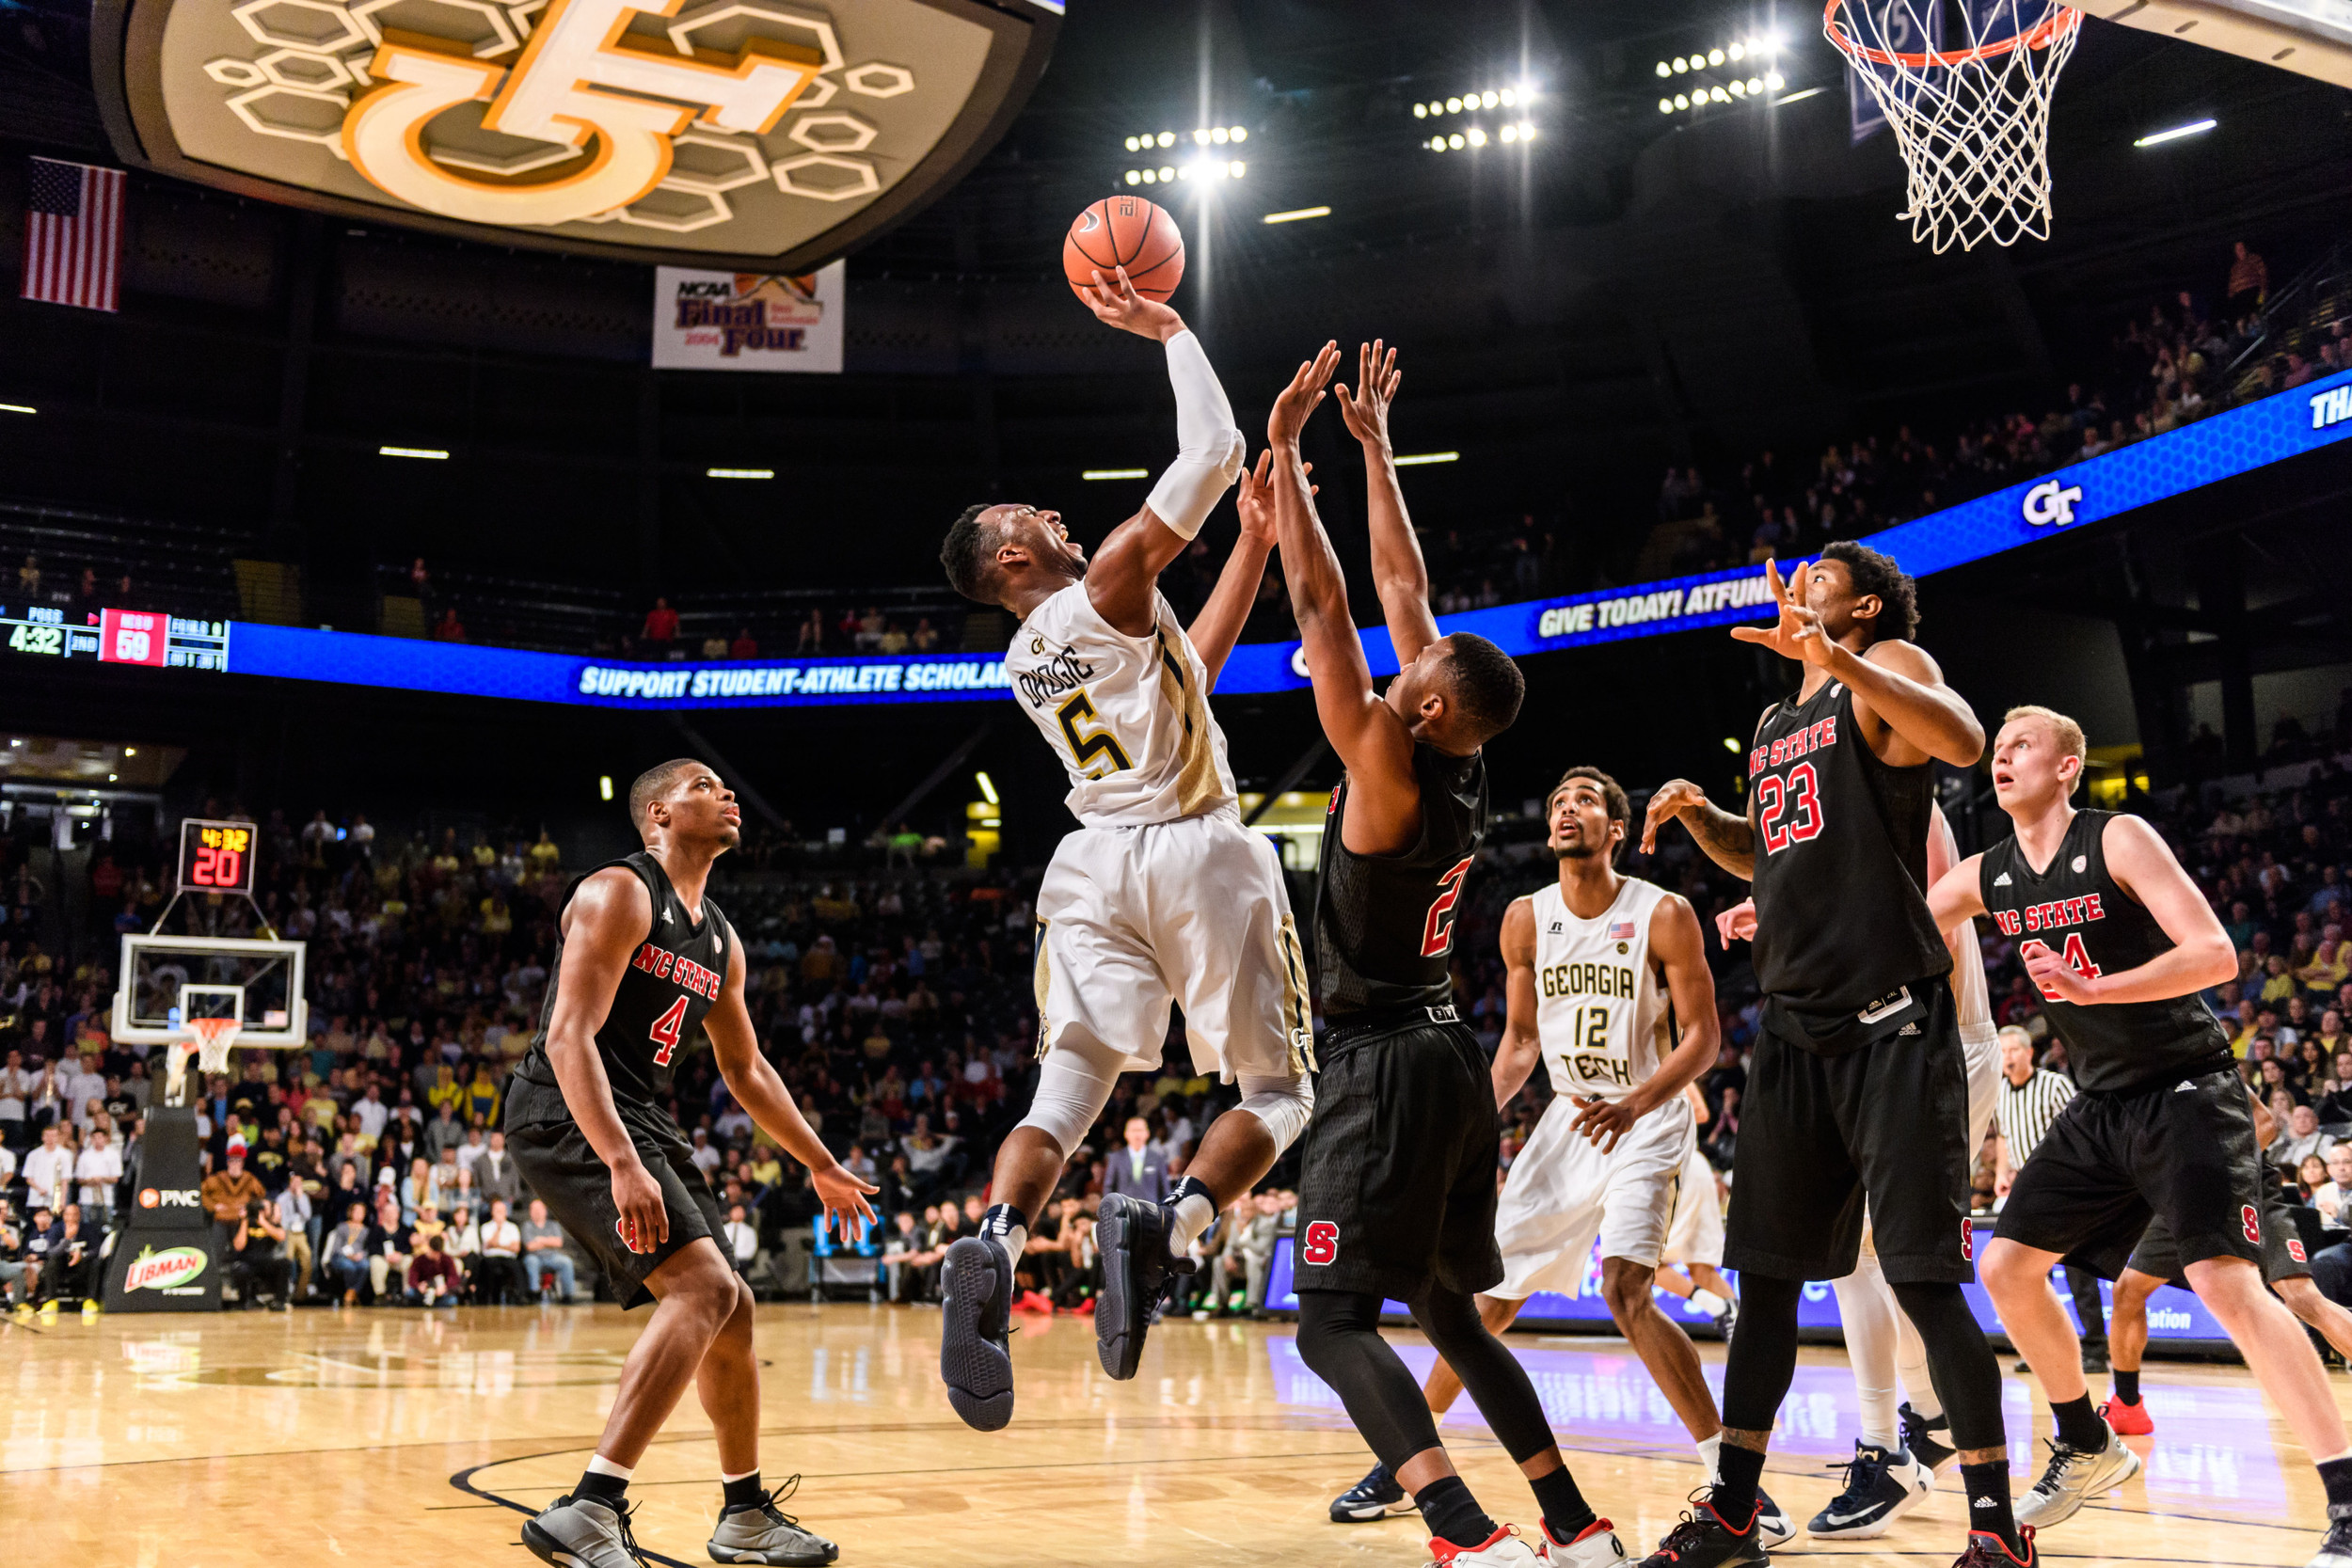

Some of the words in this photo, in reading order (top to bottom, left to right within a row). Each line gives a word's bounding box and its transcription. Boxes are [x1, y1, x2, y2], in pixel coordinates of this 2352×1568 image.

[677, 283, 730, 296] NCAA
[675, 298, 766, 328] Final
[720, 328, 805, 356] Four
[2023, 479, 2082, 526] GT
[1539, 604, 1593, 638] GIVE
[1597, 589, 1683, 628] TODAY!
[1683, 573, 1796, 615] ATFUND
[9, 625, 62, 655] 4:32
[71, 636, 98, 652] 2ND
[116, 629, 151, 661] 59
[580, 666, 691, 698] SUPPORT
[691, 664, 903, 698] STUDENT-ATHLETE
[1019, 645, 1094, 708] OKOGIE
[1055, 686, 1135, 781] 5
[1749, 745, 1769, 781] NC
[1770, 716, 1836, 767] STATE
[1757, 761, 1824, 856] 23
[201, 829, 248, 853] 4:32
[193, 847, 240, 887] 20
[1421, 854, 1475, 958] 2
[1993, 909, 2022, 936] NC
[2025, 893, 2106, 931] STATE
[632, 942, 675, 979] NC
[673, 956, 722, 1002] STATE
[1542, 963, 1635, 1001] GEORGIA
[649, 994, 690, 1068] 4
[1290, 1027, 1311, 1051] GT
[1574, 1006, 1610, 1050] 12
[1560, 1053, 1632, 1085] TECH
[160, 1189, 200, 1207] PNC
[125, 1256, 199, 1289] LIBMAN
